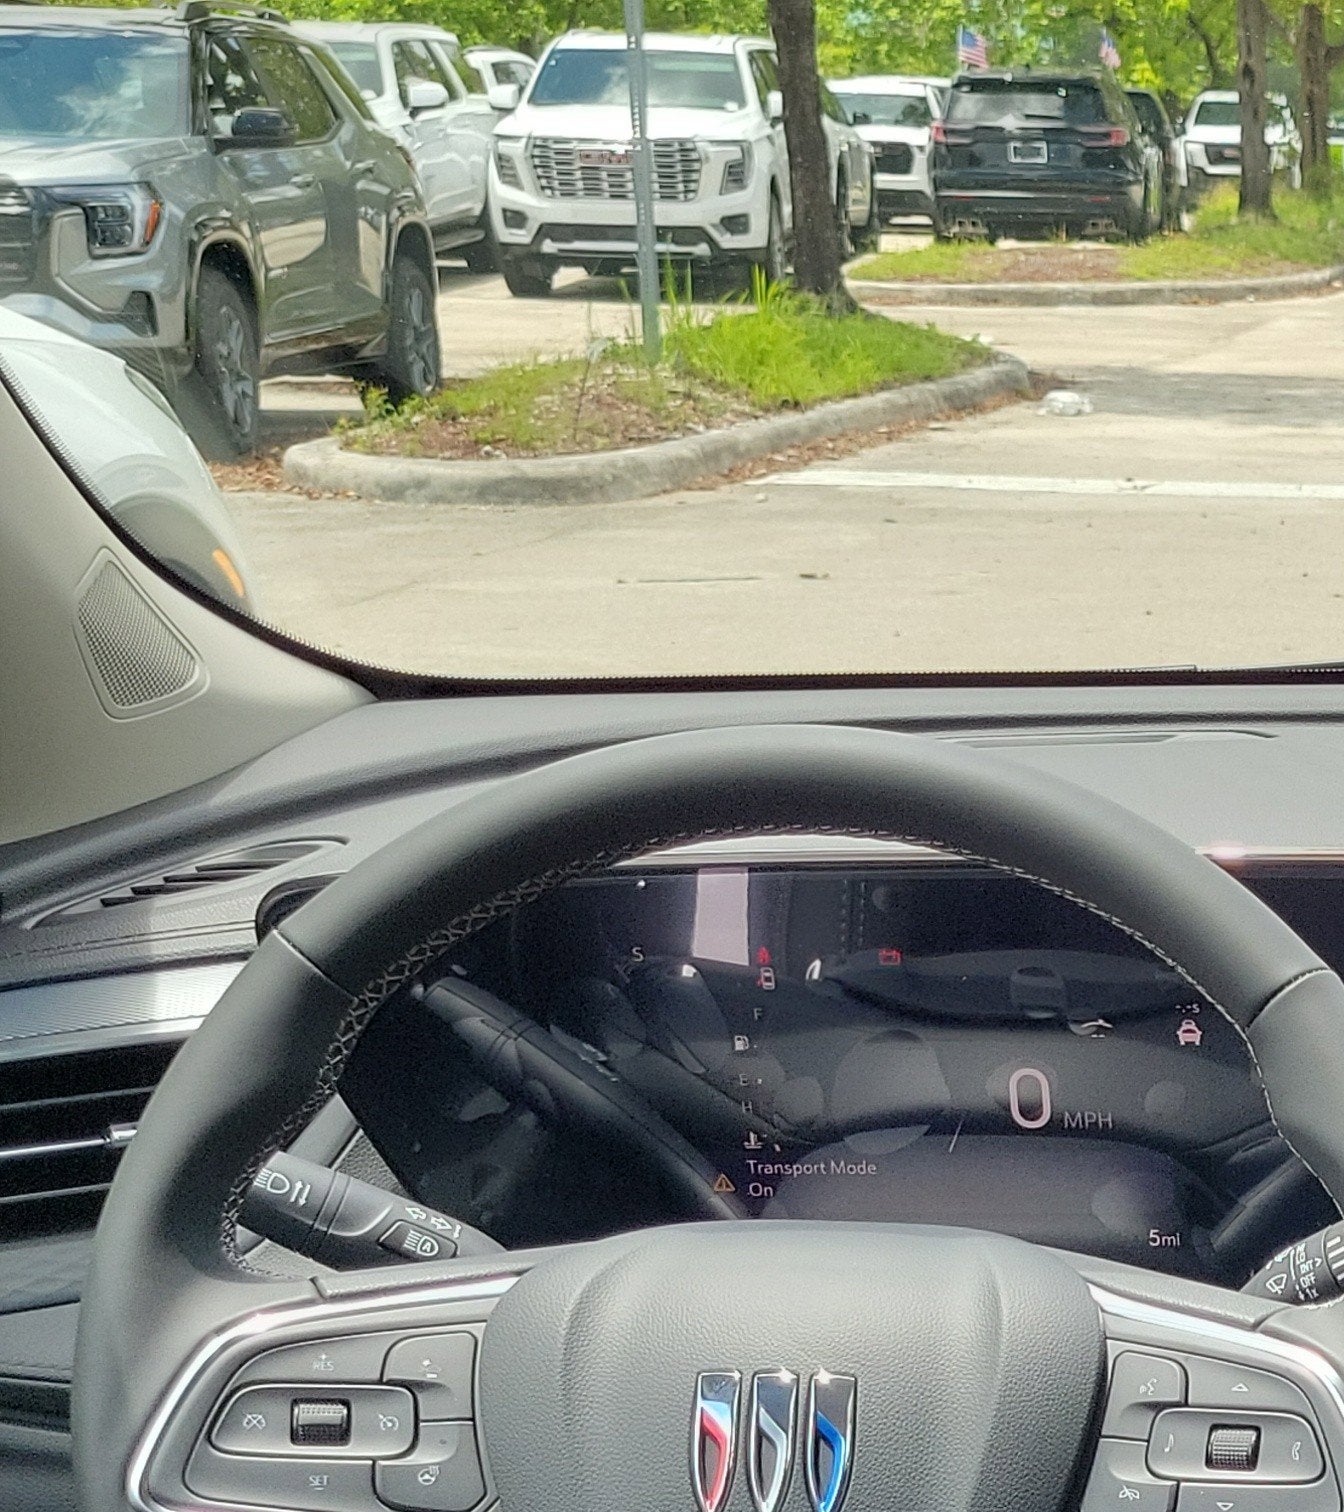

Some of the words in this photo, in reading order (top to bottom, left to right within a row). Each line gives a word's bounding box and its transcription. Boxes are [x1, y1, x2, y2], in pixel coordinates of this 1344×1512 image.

[1009, 1067, 1051, 1129] 0
[1063, 1111, 1114, 1130] MPH
[746, 1159, 827, 1179] Transport
[830, 1159, 878, 1176] Mode
[748, 1182, 774, 1198] On
[1300, 1272, 1316, 1288] OFF
[312, 1360, 335, 1371] RES
[308, 1475, 329, 1487] SET
